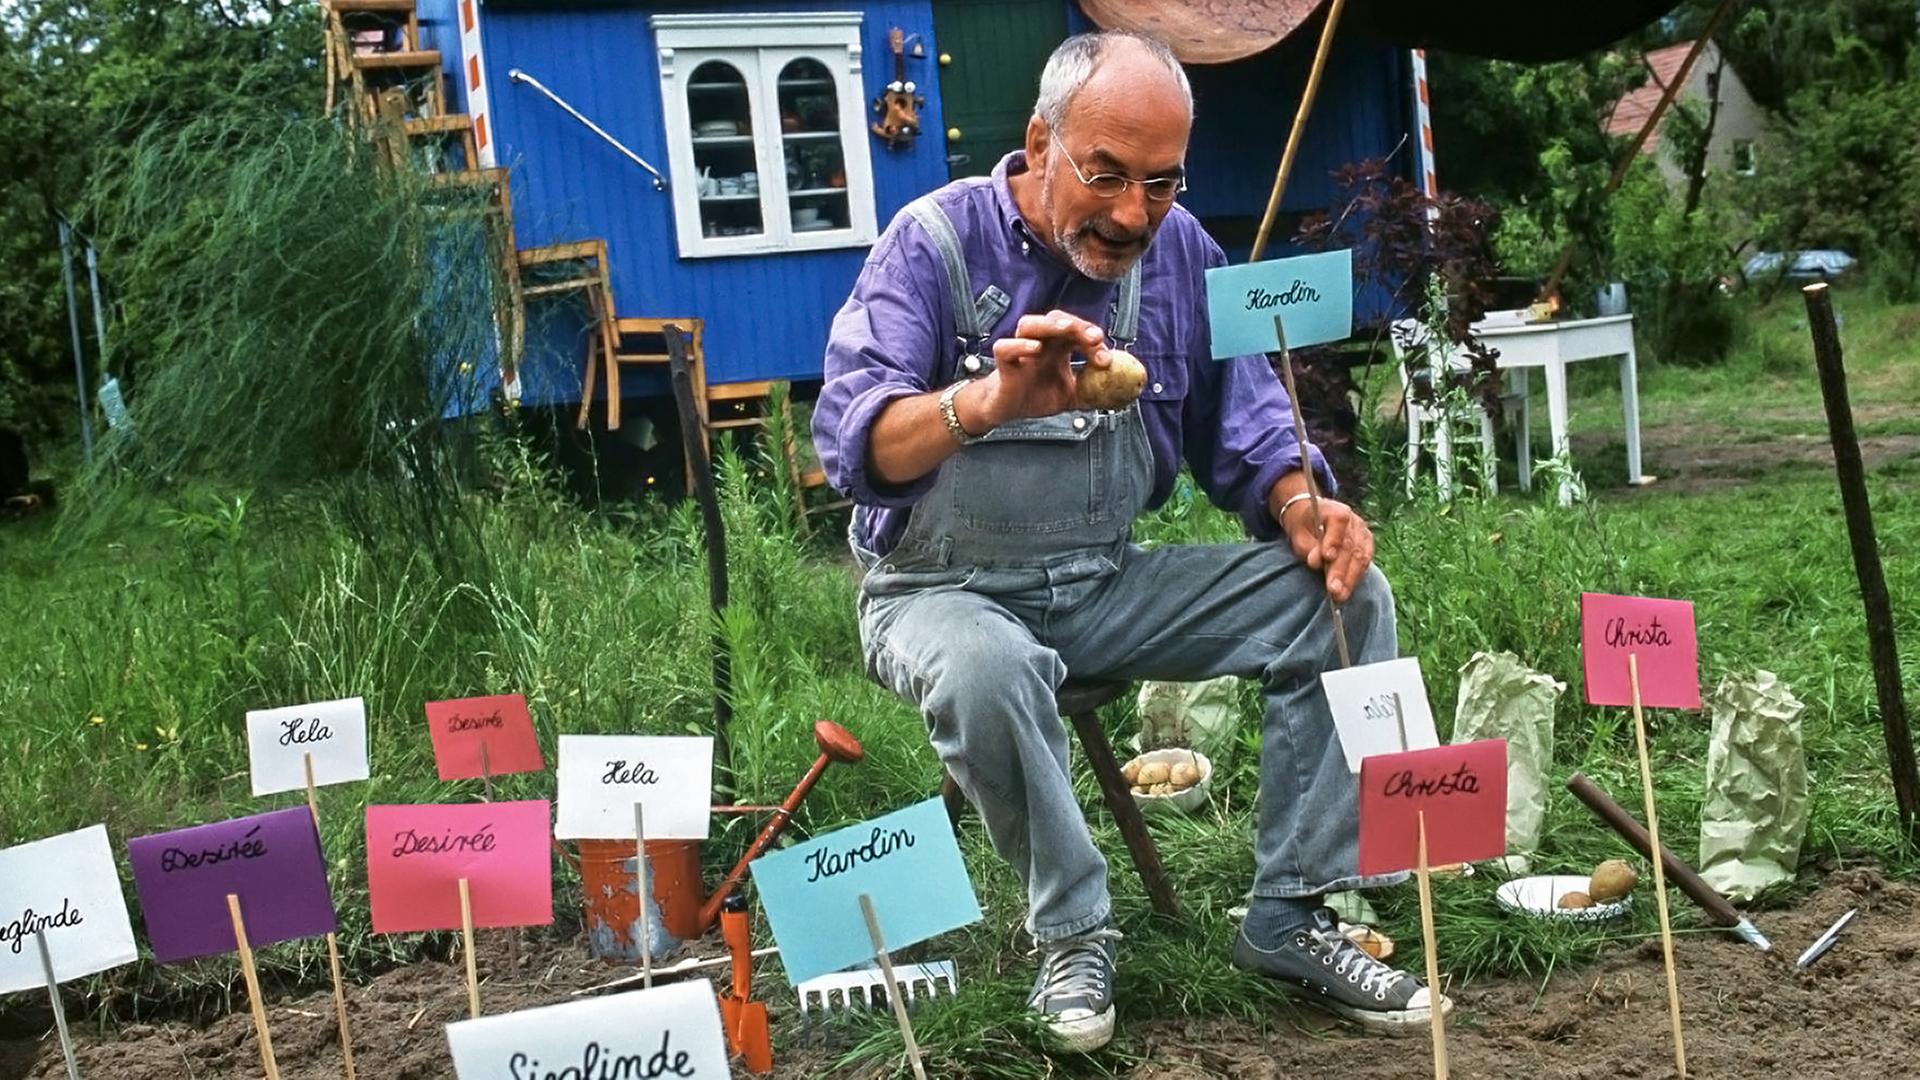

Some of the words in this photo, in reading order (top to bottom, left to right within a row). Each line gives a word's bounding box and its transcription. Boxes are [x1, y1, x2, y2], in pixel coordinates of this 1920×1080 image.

[1245, 279, 1320, 311] Karolin
[1604, 615, 1672, 649] Christa
[279, 717, 334, 746] Hela
[602, 759, 660, 785] Hela
[1383, 761, 1480, 798] Christa
[160, 825, 268, 873] Desirée
[392, 823, 497, 858] Desirée
[804, 826, 915, 882] Karolin
[0, 897, 84, 954] eglinde
